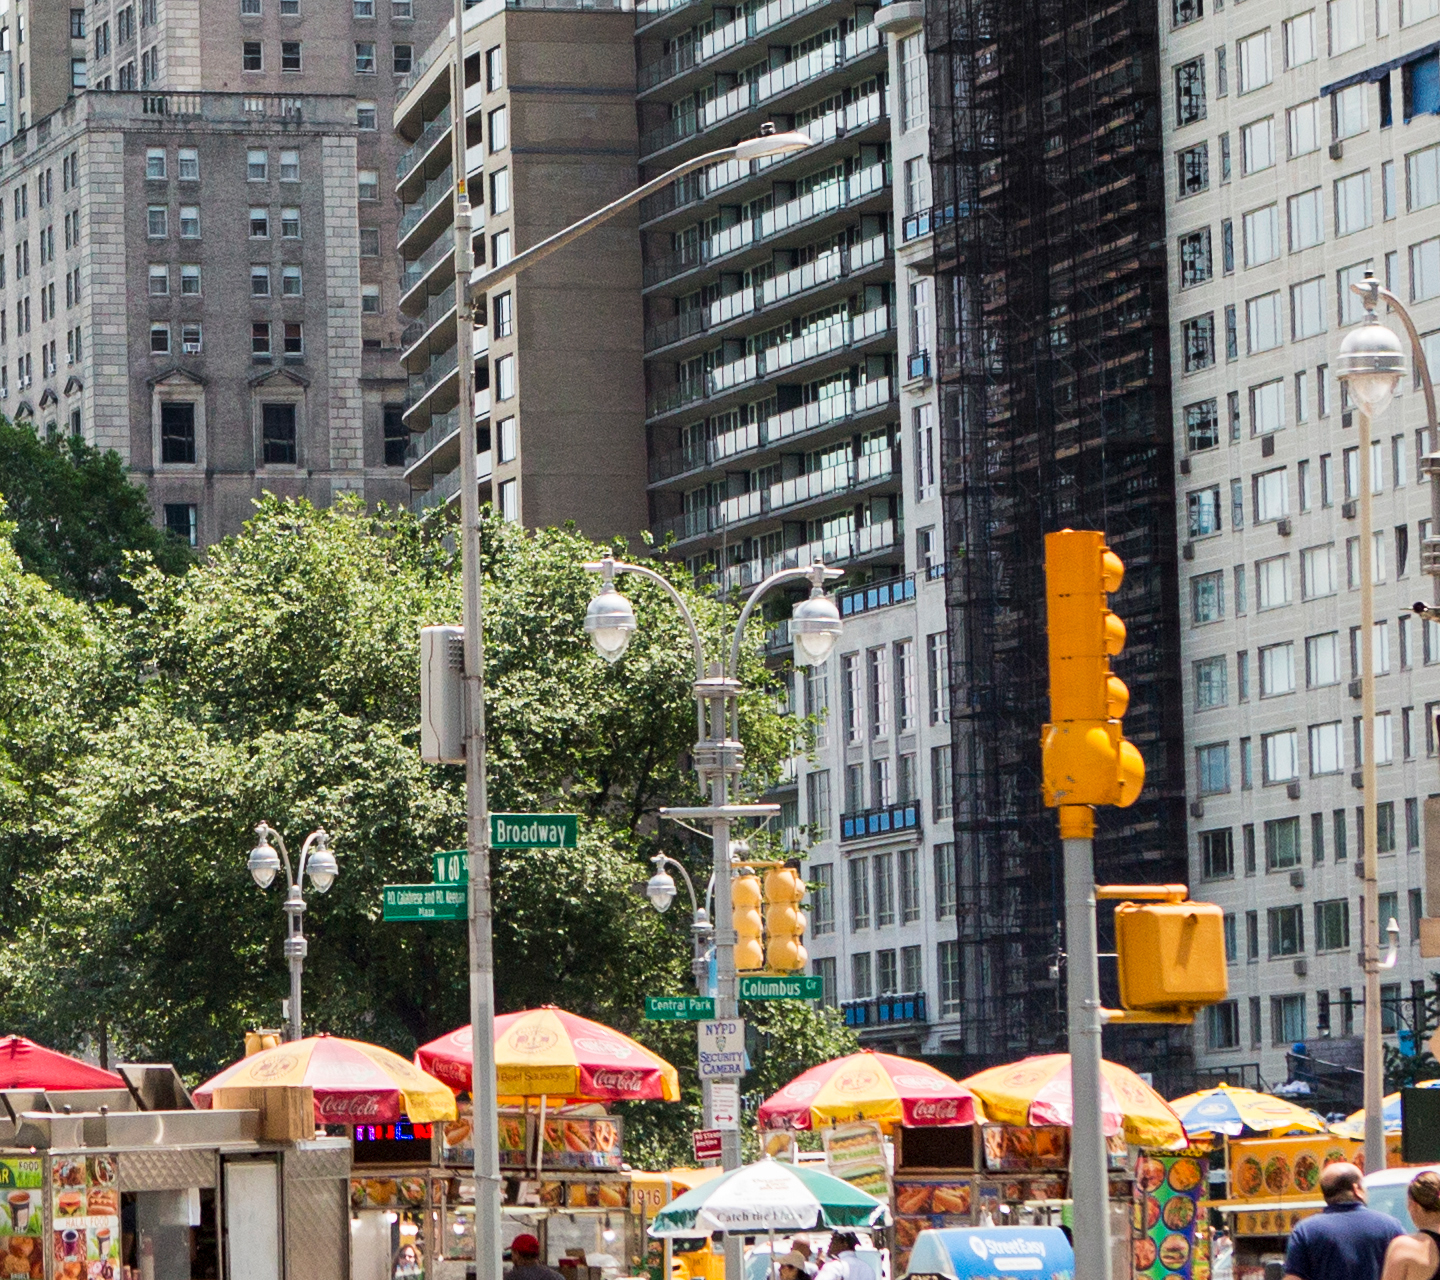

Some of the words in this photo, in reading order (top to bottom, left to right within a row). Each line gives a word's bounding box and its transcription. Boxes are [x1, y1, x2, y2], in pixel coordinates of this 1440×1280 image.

[497, 819, 566, 848] Broadway
[436, 856, 446, 883] W
[448, 854, 460, 881] 60
[424, 890, 435, 905] and
[418, 907, 435, 917] Plaza
[741, 979, 801, 997] Columbus
[805, 979, 818, 991] Cir
[650, 999, 686, 1011] Central
[689, 999, 712, 1011] Park
[705, 1023, 737, 1037] NYPD
[699, 1051, 743, 1064] SECURITY
[702, 1063, 742, 1076] CAMERA
[524, 1072, 570, 1083] Sausages
[18, 1160, 39, 1171] FOOD
[631, 1188, 662, 1206] 1916
[716, 1211, 749, 1222] Catch
[984, 1238, 1047, 1258] StreetEasy
